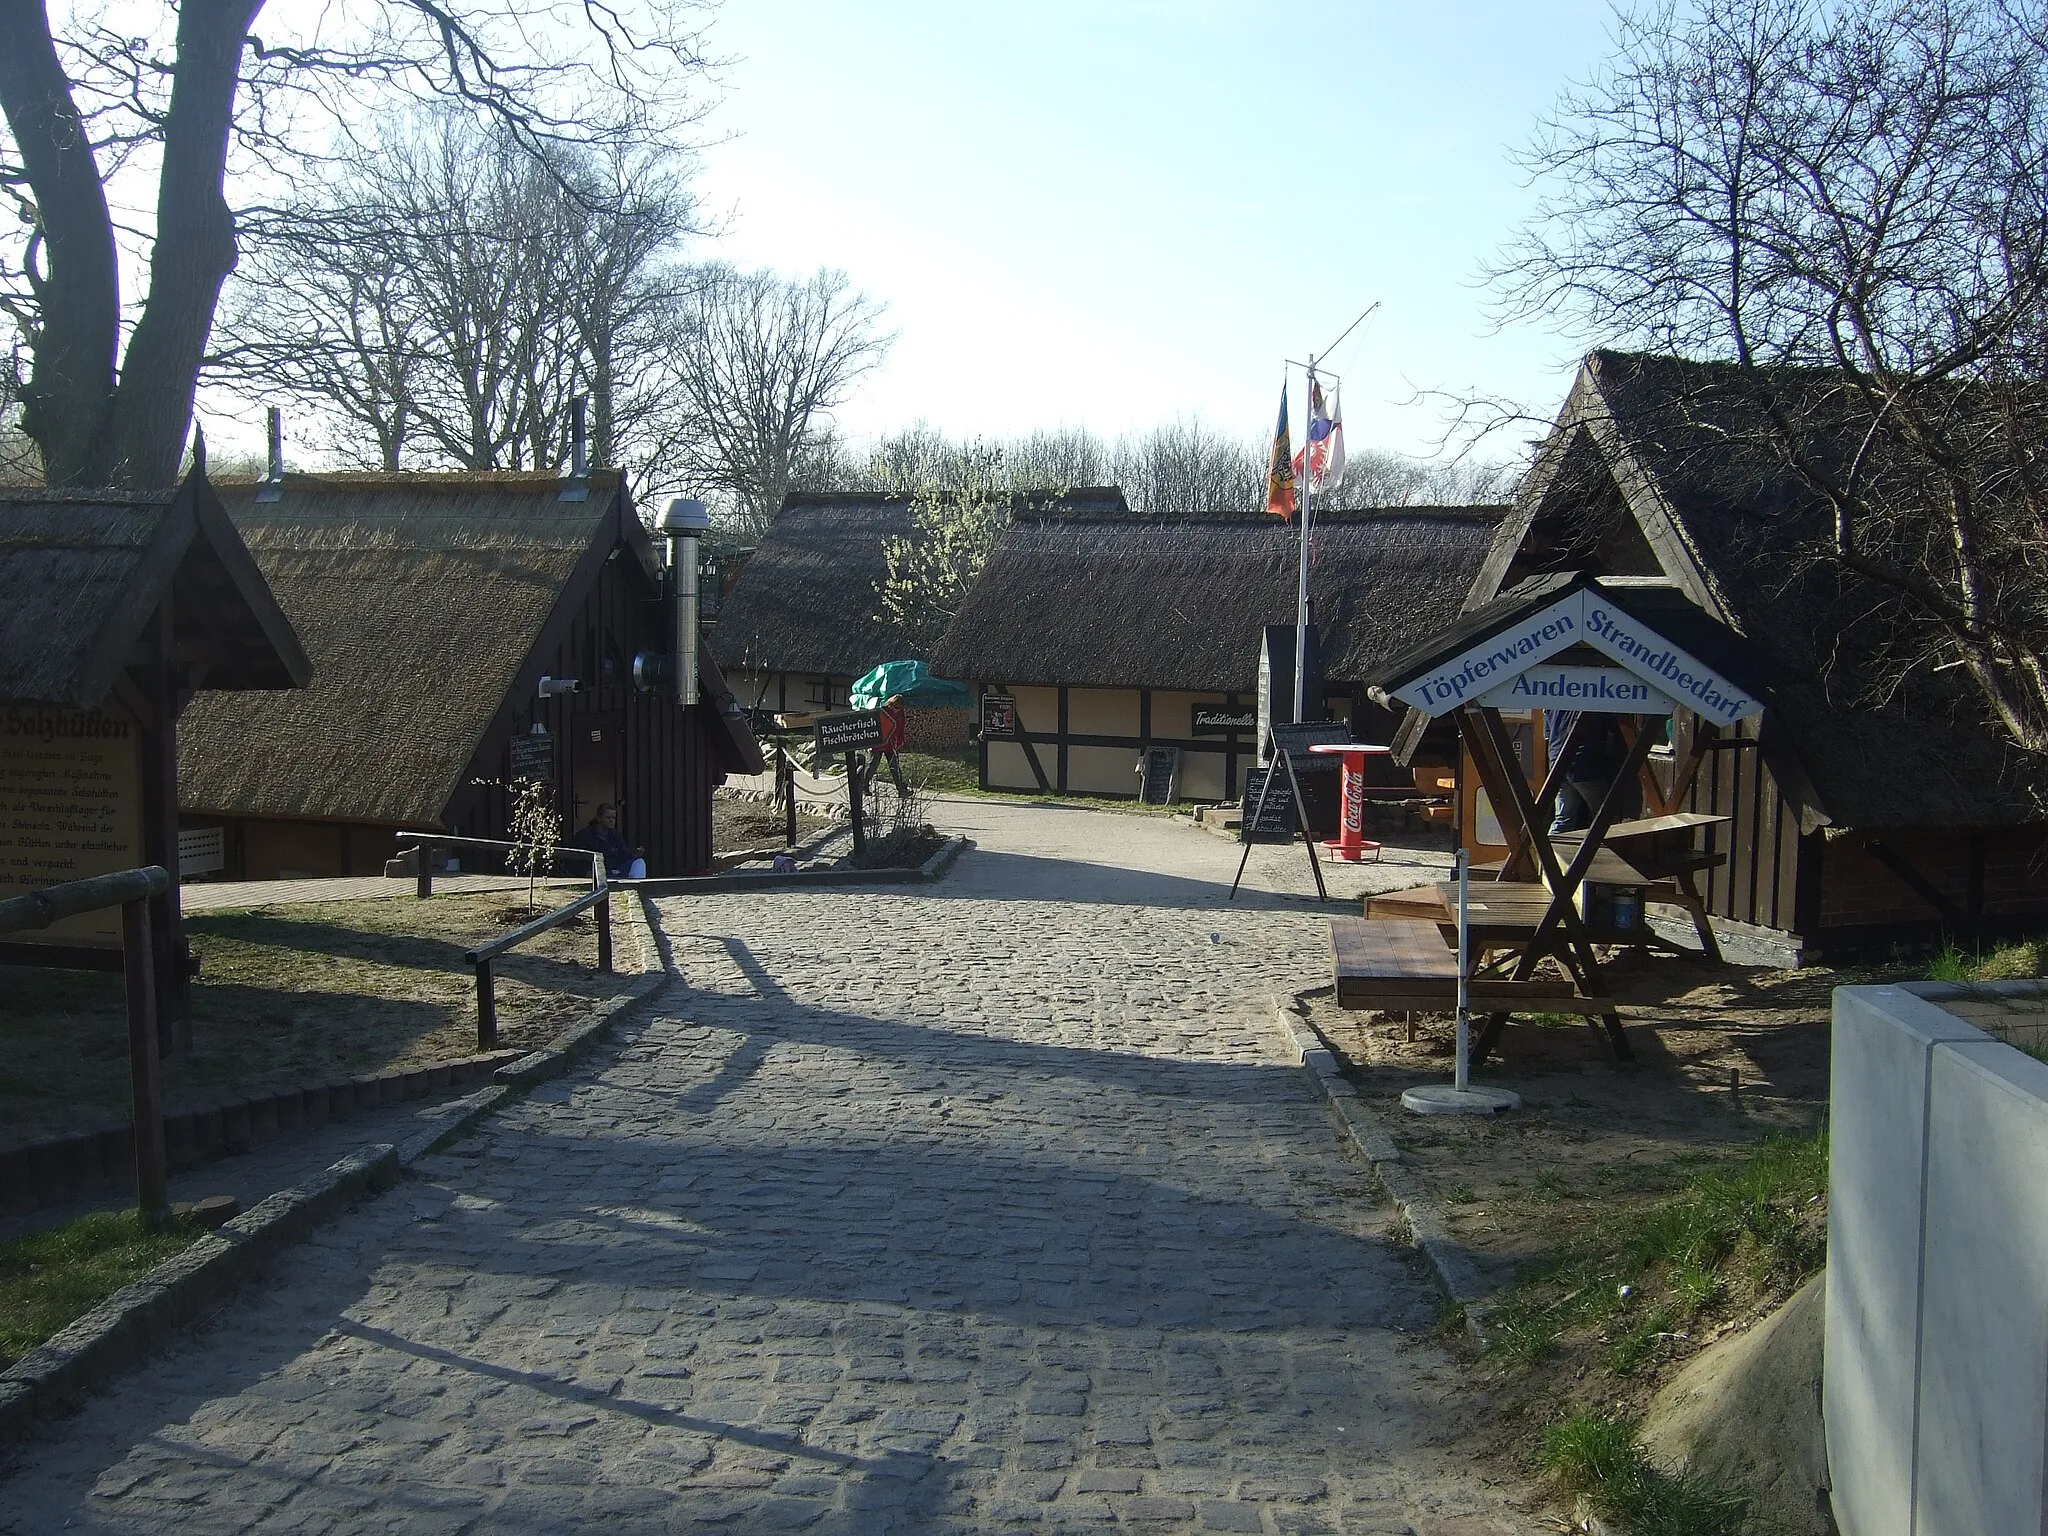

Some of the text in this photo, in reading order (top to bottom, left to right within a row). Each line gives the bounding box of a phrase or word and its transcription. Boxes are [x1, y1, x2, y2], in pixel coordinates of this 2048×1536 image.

[1414, 615, 1575, 706] Töpferwaren
[1586, 609, 1748, 718] Strandbedarf
[1511, 673, 1648, 700] Andenken
[821, 717, 877, 735] Räucherfisch
[1196, 711, 1256, 726] Traditionelle
[822, 729, 880, 746] Fischbrötchen
[81, 840, 128, 852] staatlicher
